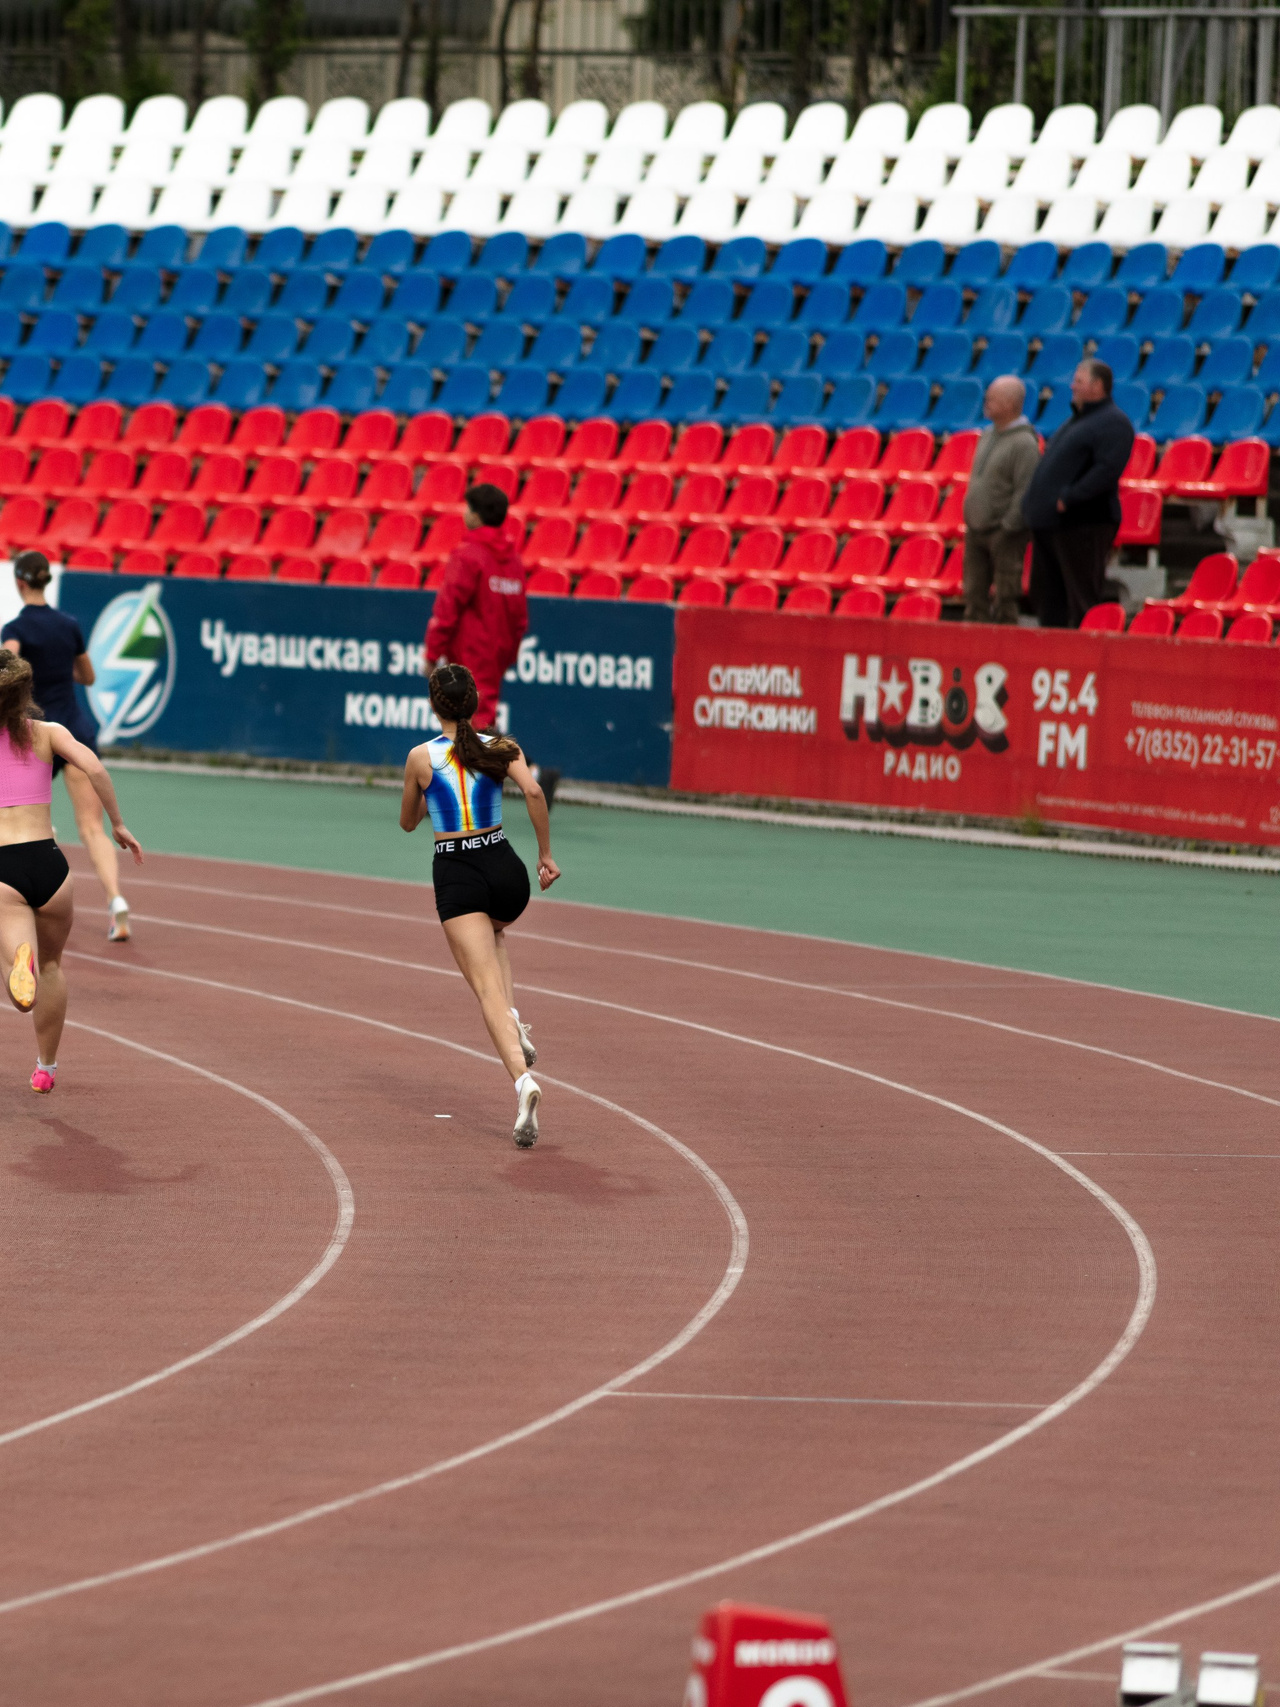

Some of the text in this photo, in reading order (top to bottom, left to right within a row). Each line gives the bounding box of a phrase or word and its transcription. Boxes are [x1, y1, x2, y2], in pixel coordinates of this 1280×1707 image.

[201, 619, 654, 690] Чувашская энбытовая
[344, 691, 510, 736] компя
[1031, 667, 1098, 716] 95.4
[883, 749, 962, 782] РАДИО
[1037, 720, 1087, 771] FM
